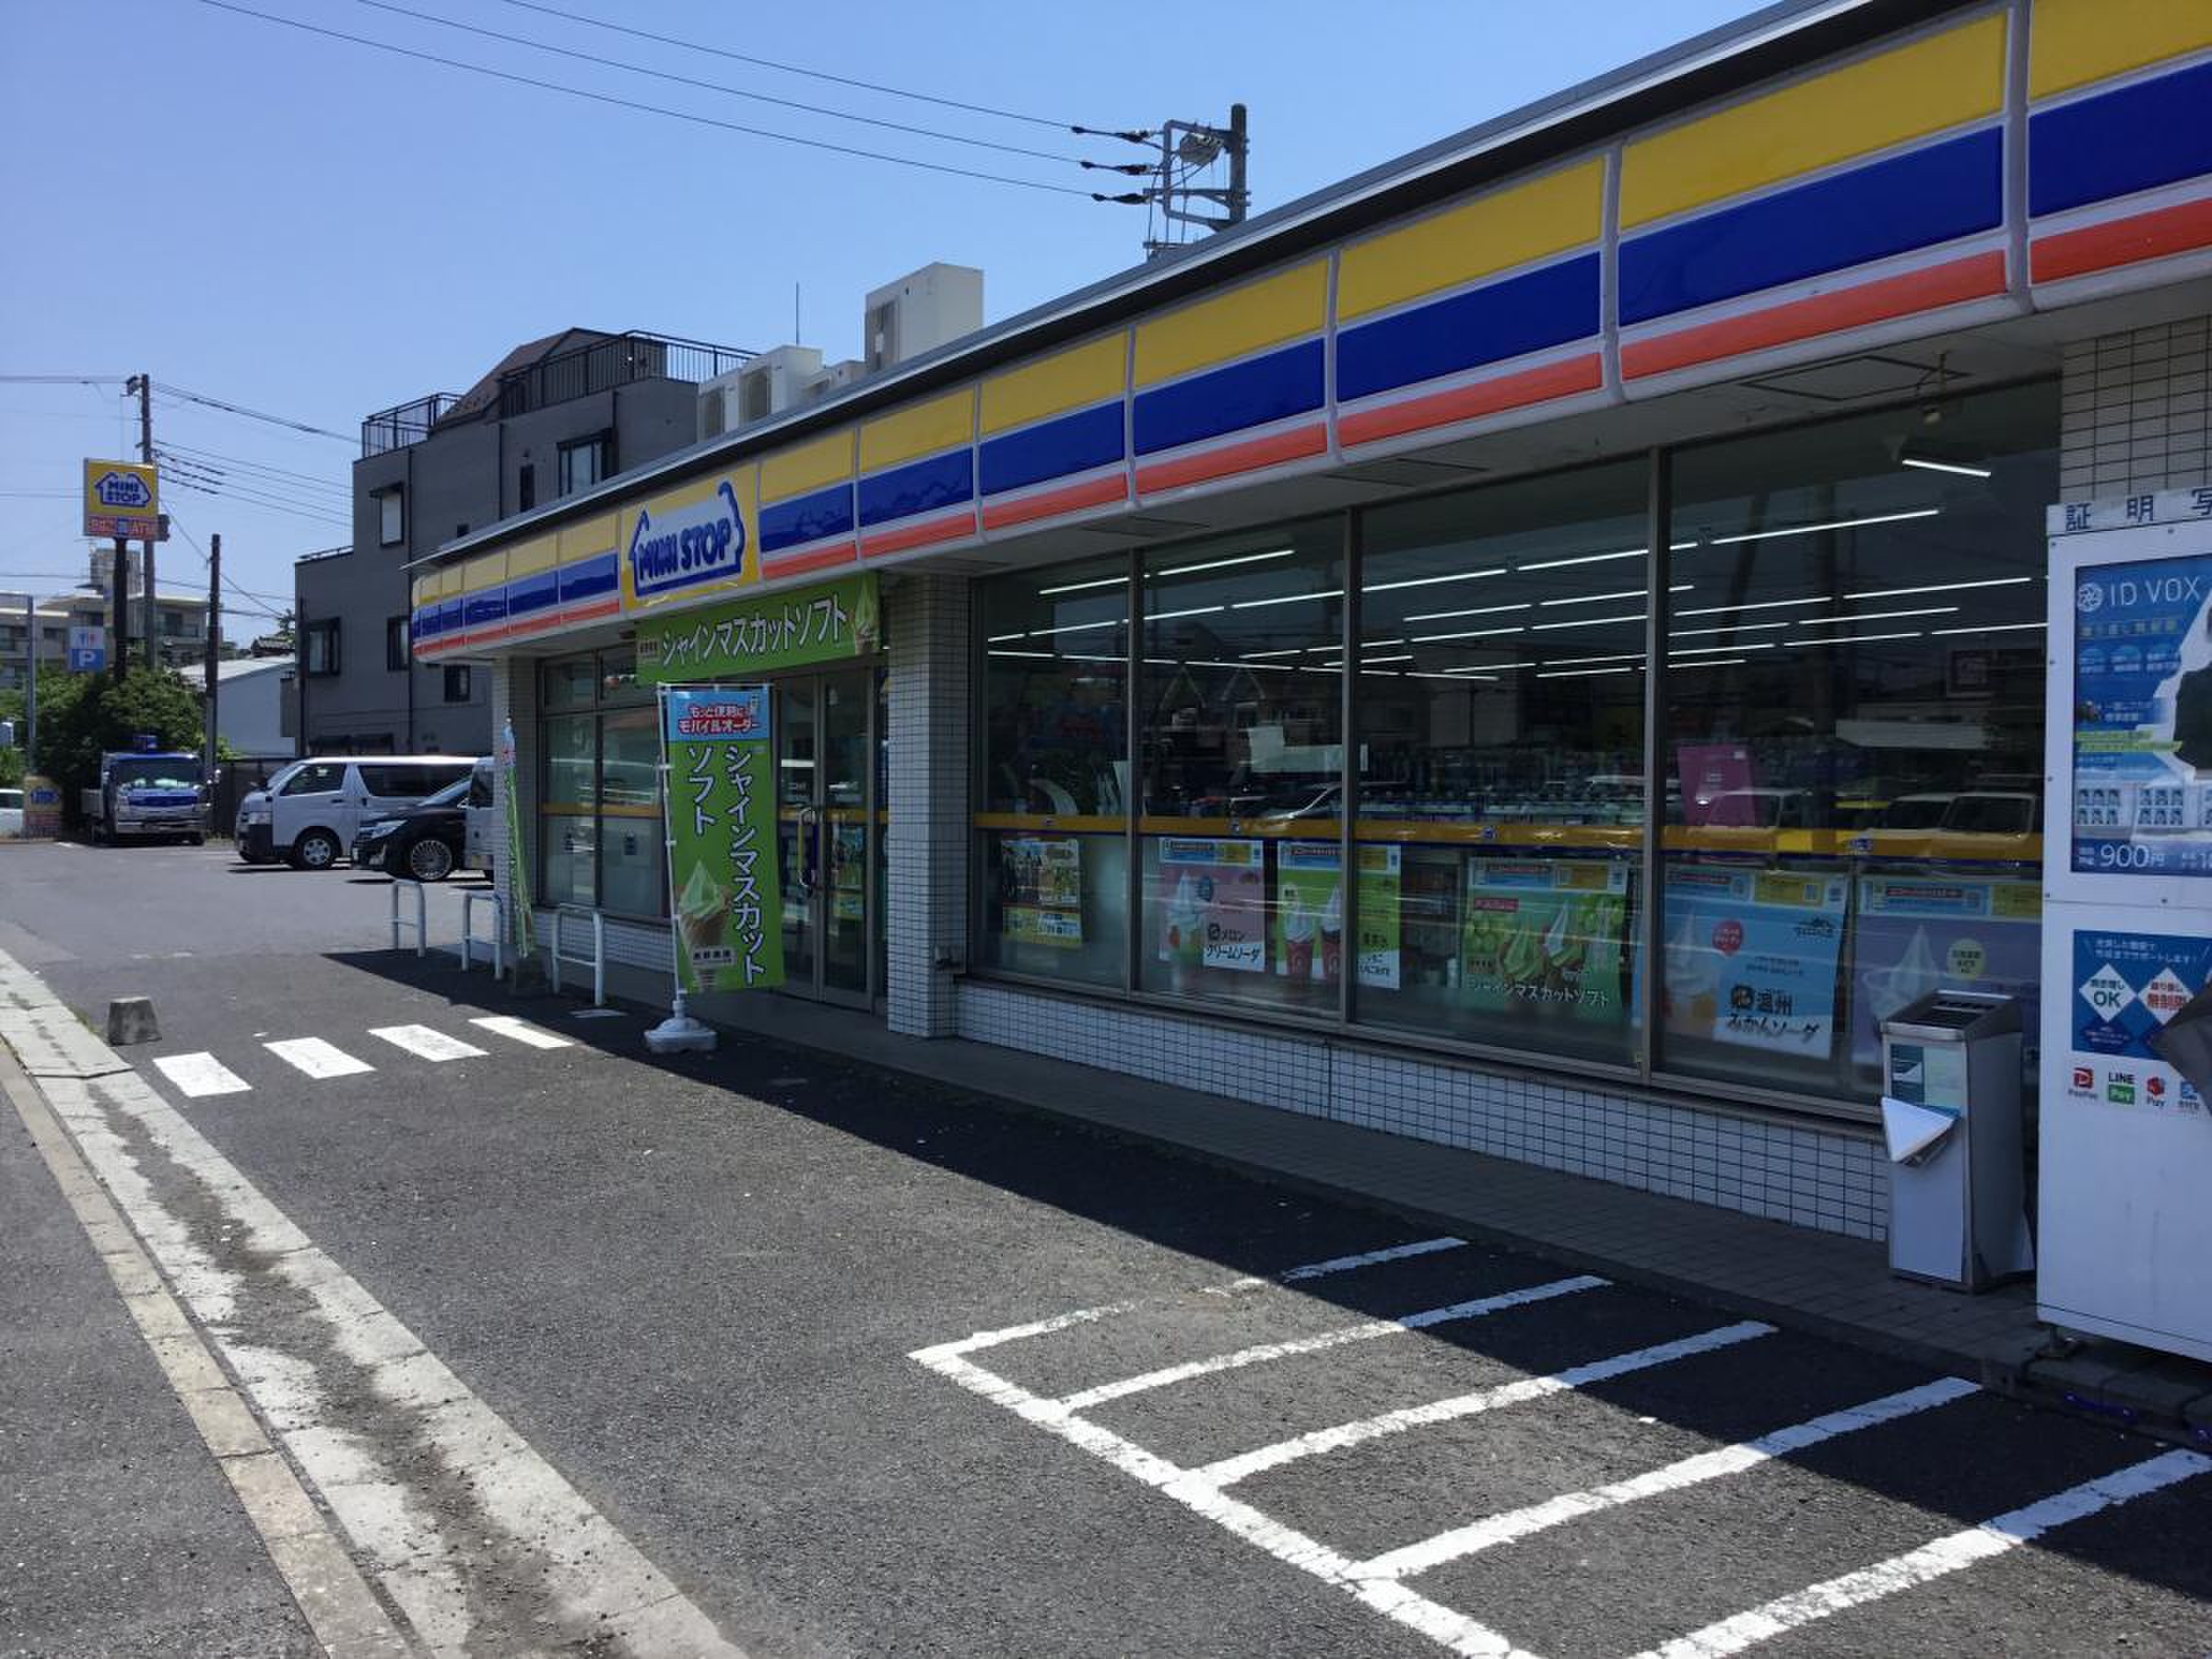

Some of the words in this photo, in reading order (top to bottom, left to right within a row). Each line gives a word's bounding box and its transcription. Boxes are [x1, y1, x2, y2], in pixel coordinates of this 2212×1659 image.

[638, 532, 678, 582] MINI
[679, 517, 732, 574] STOP
[2110, 582, 2137, 606] ID
[2145, 576, 2201, 605] VOX
[662, 593, 848, 667] シャインマスカットソフト
[688, 745, 716, 836] ソフト
[724, 745, 766, 984] シャインマスカット
[2093, 990, 2121, 1007] OK
[2108, 1072, 2136, 1085] LINE
